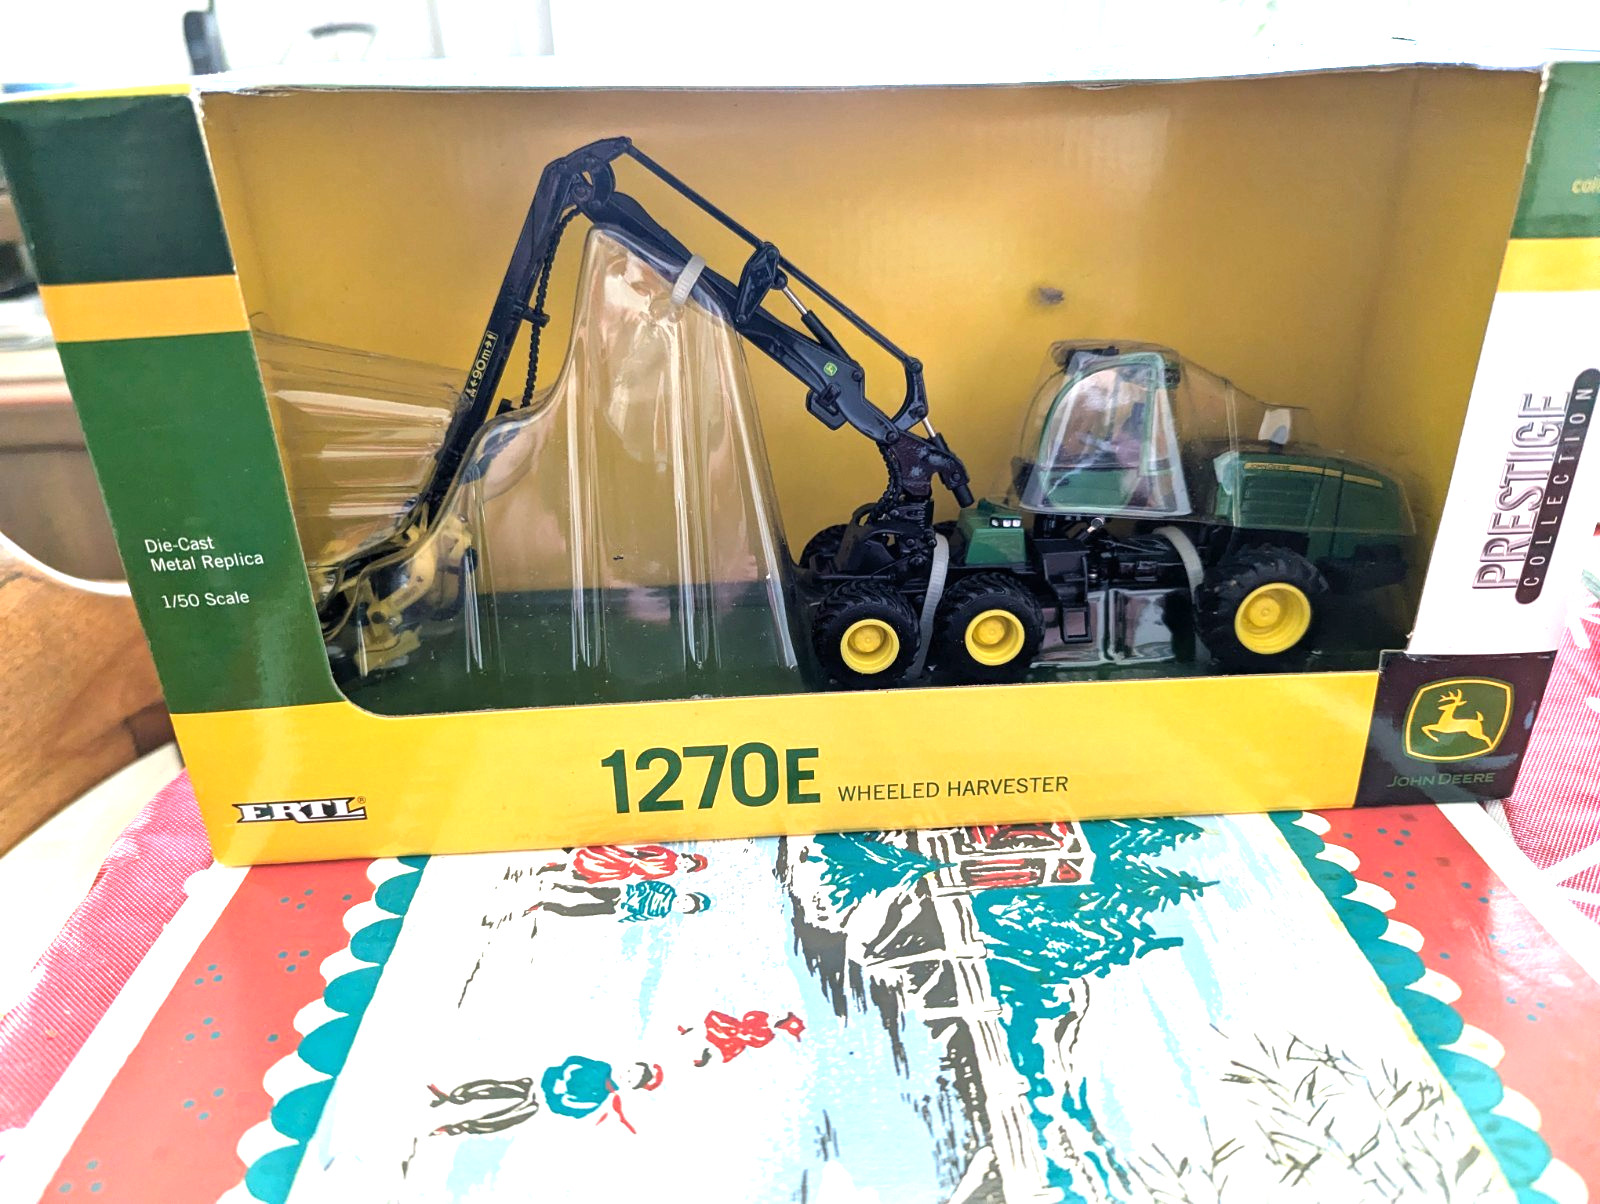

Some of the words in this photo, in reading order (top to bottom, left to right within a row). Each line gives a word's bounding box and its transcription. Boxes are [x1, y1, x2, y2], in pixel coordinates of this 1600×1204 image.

[1472, 391, 1572, 590] PRESTIGE
[1523, 388, 1594, 587] COLLECTION
[144, 536, 214, 553] Die-Cast
[150, 557, 196, 573] Metal
[201, 552, 264, 571] Replica
[161, 593, 200, 609] 1/50
[205, 591, 250, 607] Scale
[600, 742, 821, 814] 1270E
[838, 782, 940, 802] WHEELED
[947, 776, 1069, 797] HARVESTER
[1386, 774, 1435, 788] JOHN
[1438, 772, 1496, 785] DEERE
